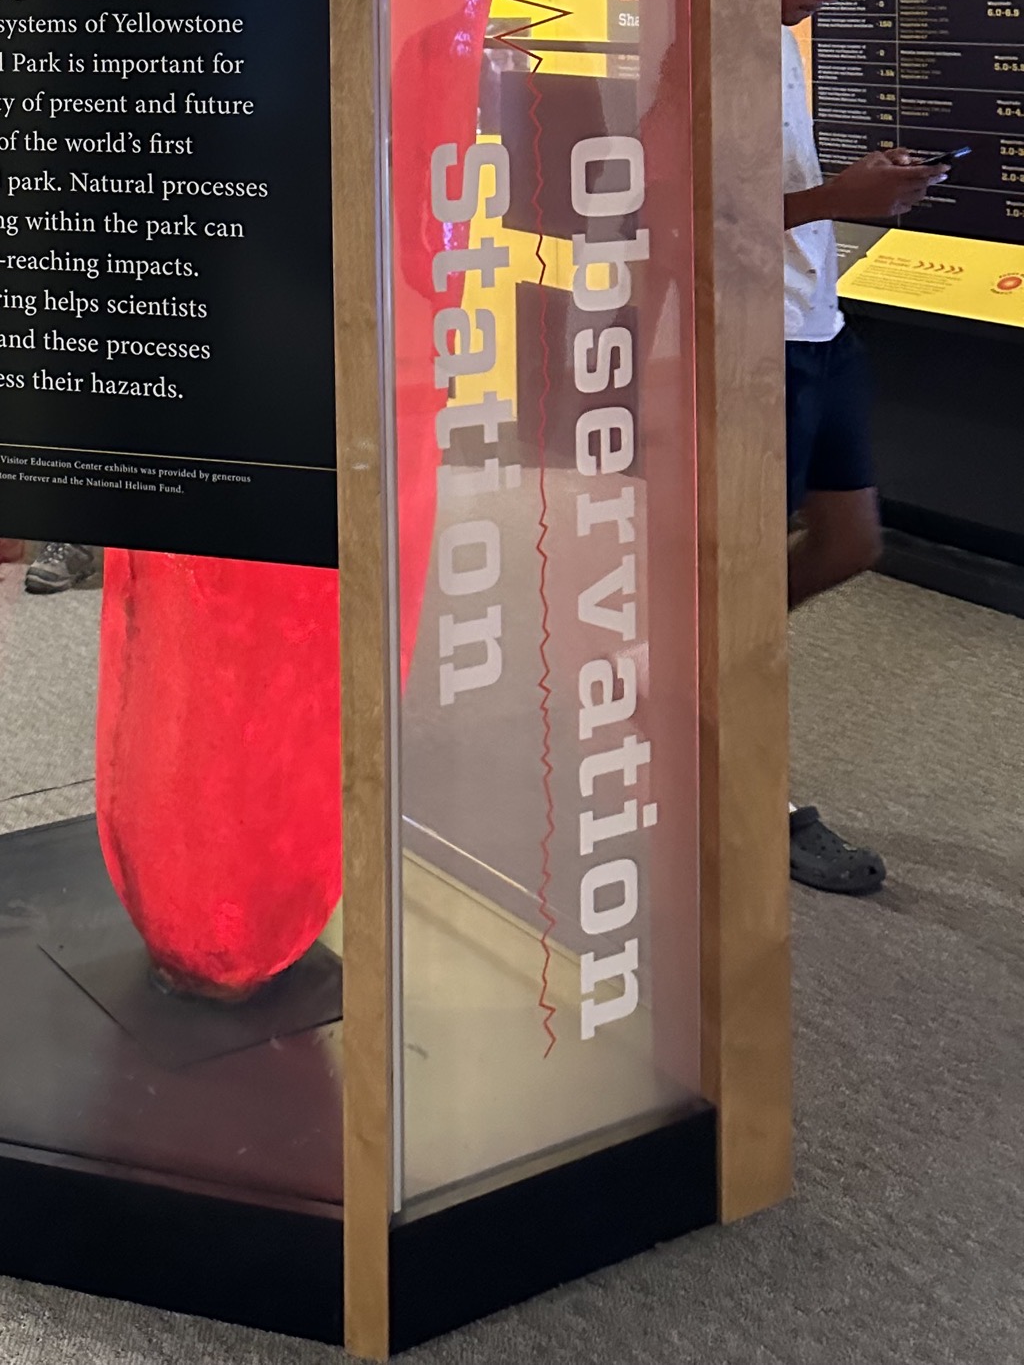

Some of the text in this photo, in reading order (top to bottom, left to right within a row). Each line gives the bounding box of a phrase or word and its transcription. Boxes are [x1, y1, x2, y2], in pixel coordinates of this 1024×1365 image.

[85, 12, 108, 32] of
[112, 12, 243, 32] Yellowstone
[618, 13, 640, 27] Sha
[13, 52, 61, 72] Park
[69, 54, 84, 72] is
[93, 54, 204, 79] important
[213, 52, 244, 73] for
[22, 91, 45, 111] of
[50, 96, 127, 118] present
[136, 93, 176, 113] and
[185, 93, 253, 114] future
[24, 131, 57, 151] the
[65, 132, 141, 153] world’s
[150, 133, 193, 154] first
[8, 171, 61, 196] park.
[70, 173, 153, 193] Natural
[163, 181, 267, 200] processes
[25, 211, 95, 232] within
[104, 213, 137, 233] the
[146, 215, 197, 240] park
[205, 223, 244, 237] can
[107, 254, 198, 280] impacts.
[44, 290, 98, 318] helps
[107, 295, 207, 318] scientists
[44, 330, 98, 352] these
[107, 340, 210, 360] processes
[33, 369, 83, 391] their
[91, 372, 183, 398] hazards.
[431, 142, 521, 706] Station
[0, 456, 28, 465] Visitor
[30, 459, 72, 469] Education
[74, 462, 102, 471] Center
[104, 464, 138, 474] exhibits
[158, 468, 197, 480] provided
[198, 471, 210, 481] by
[212, 474, 251, 484] generous
[20, 473, 49, 482] Forever
[71, 477, 83, 485] the
[87, 478, 122, 488] National
[126, 481, 156, 491] Helium
[160, 484, 183, 493] Fund.
[570, 135, 657, 1040] Observation
